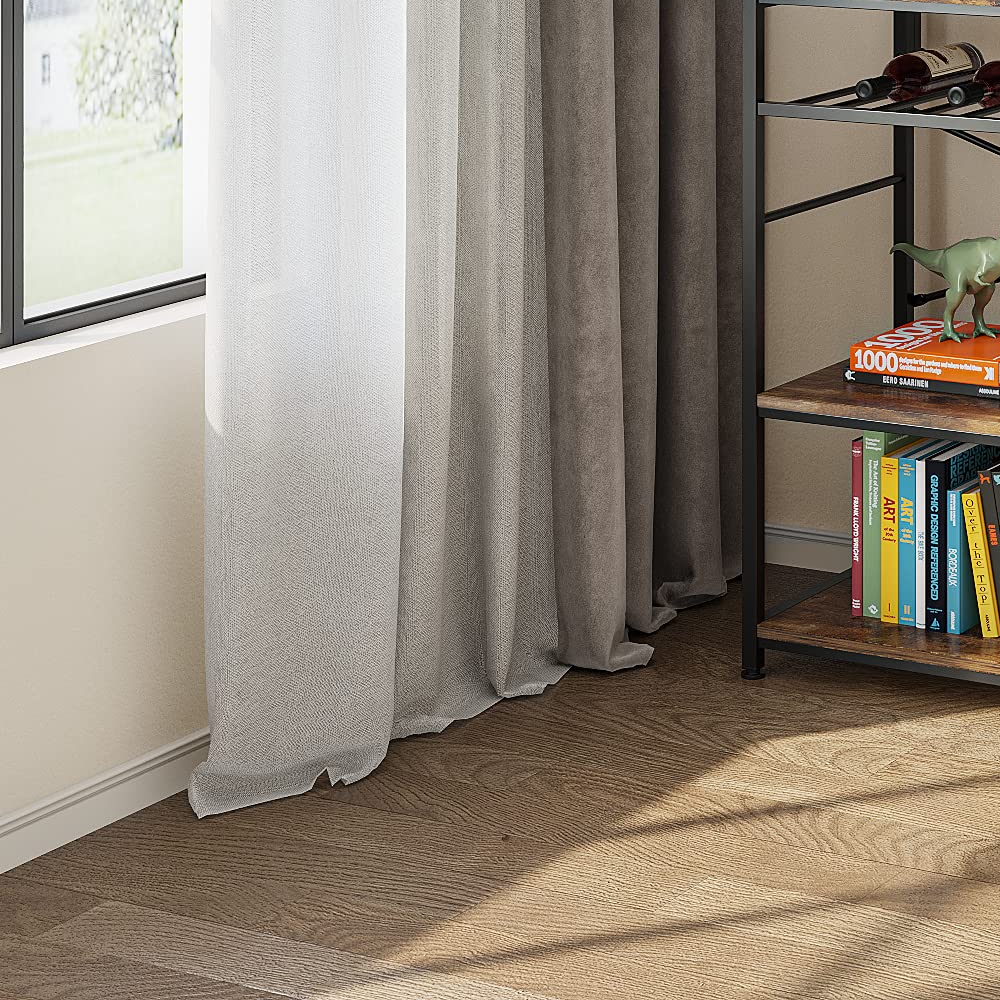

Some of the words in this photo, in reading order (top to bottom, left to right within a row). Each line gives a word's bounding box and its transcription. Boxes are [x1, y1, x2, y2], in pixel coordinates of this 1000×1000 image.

[854, 349, 898, 373] 1000
[882, 375, 898, 385] EERO
[898, 377, 929, 389] SAARINEN
[930, 475, 939, 512] GRAPHIC
[883, 496, 896, 524] ART
[900, 496, 914, 525] ART
[852, 517, 860, 537] LLOYD
[930, 513, 939, 544] DESIGN
[988, 524, 999, 546] EAMES
[852, 537, 860, 562] WRIGHT
[930, 546, 939, 600] REFERENCED
[948, 548, 957, 587] BORDEAUX
[976, 574, 987, 604] Top
